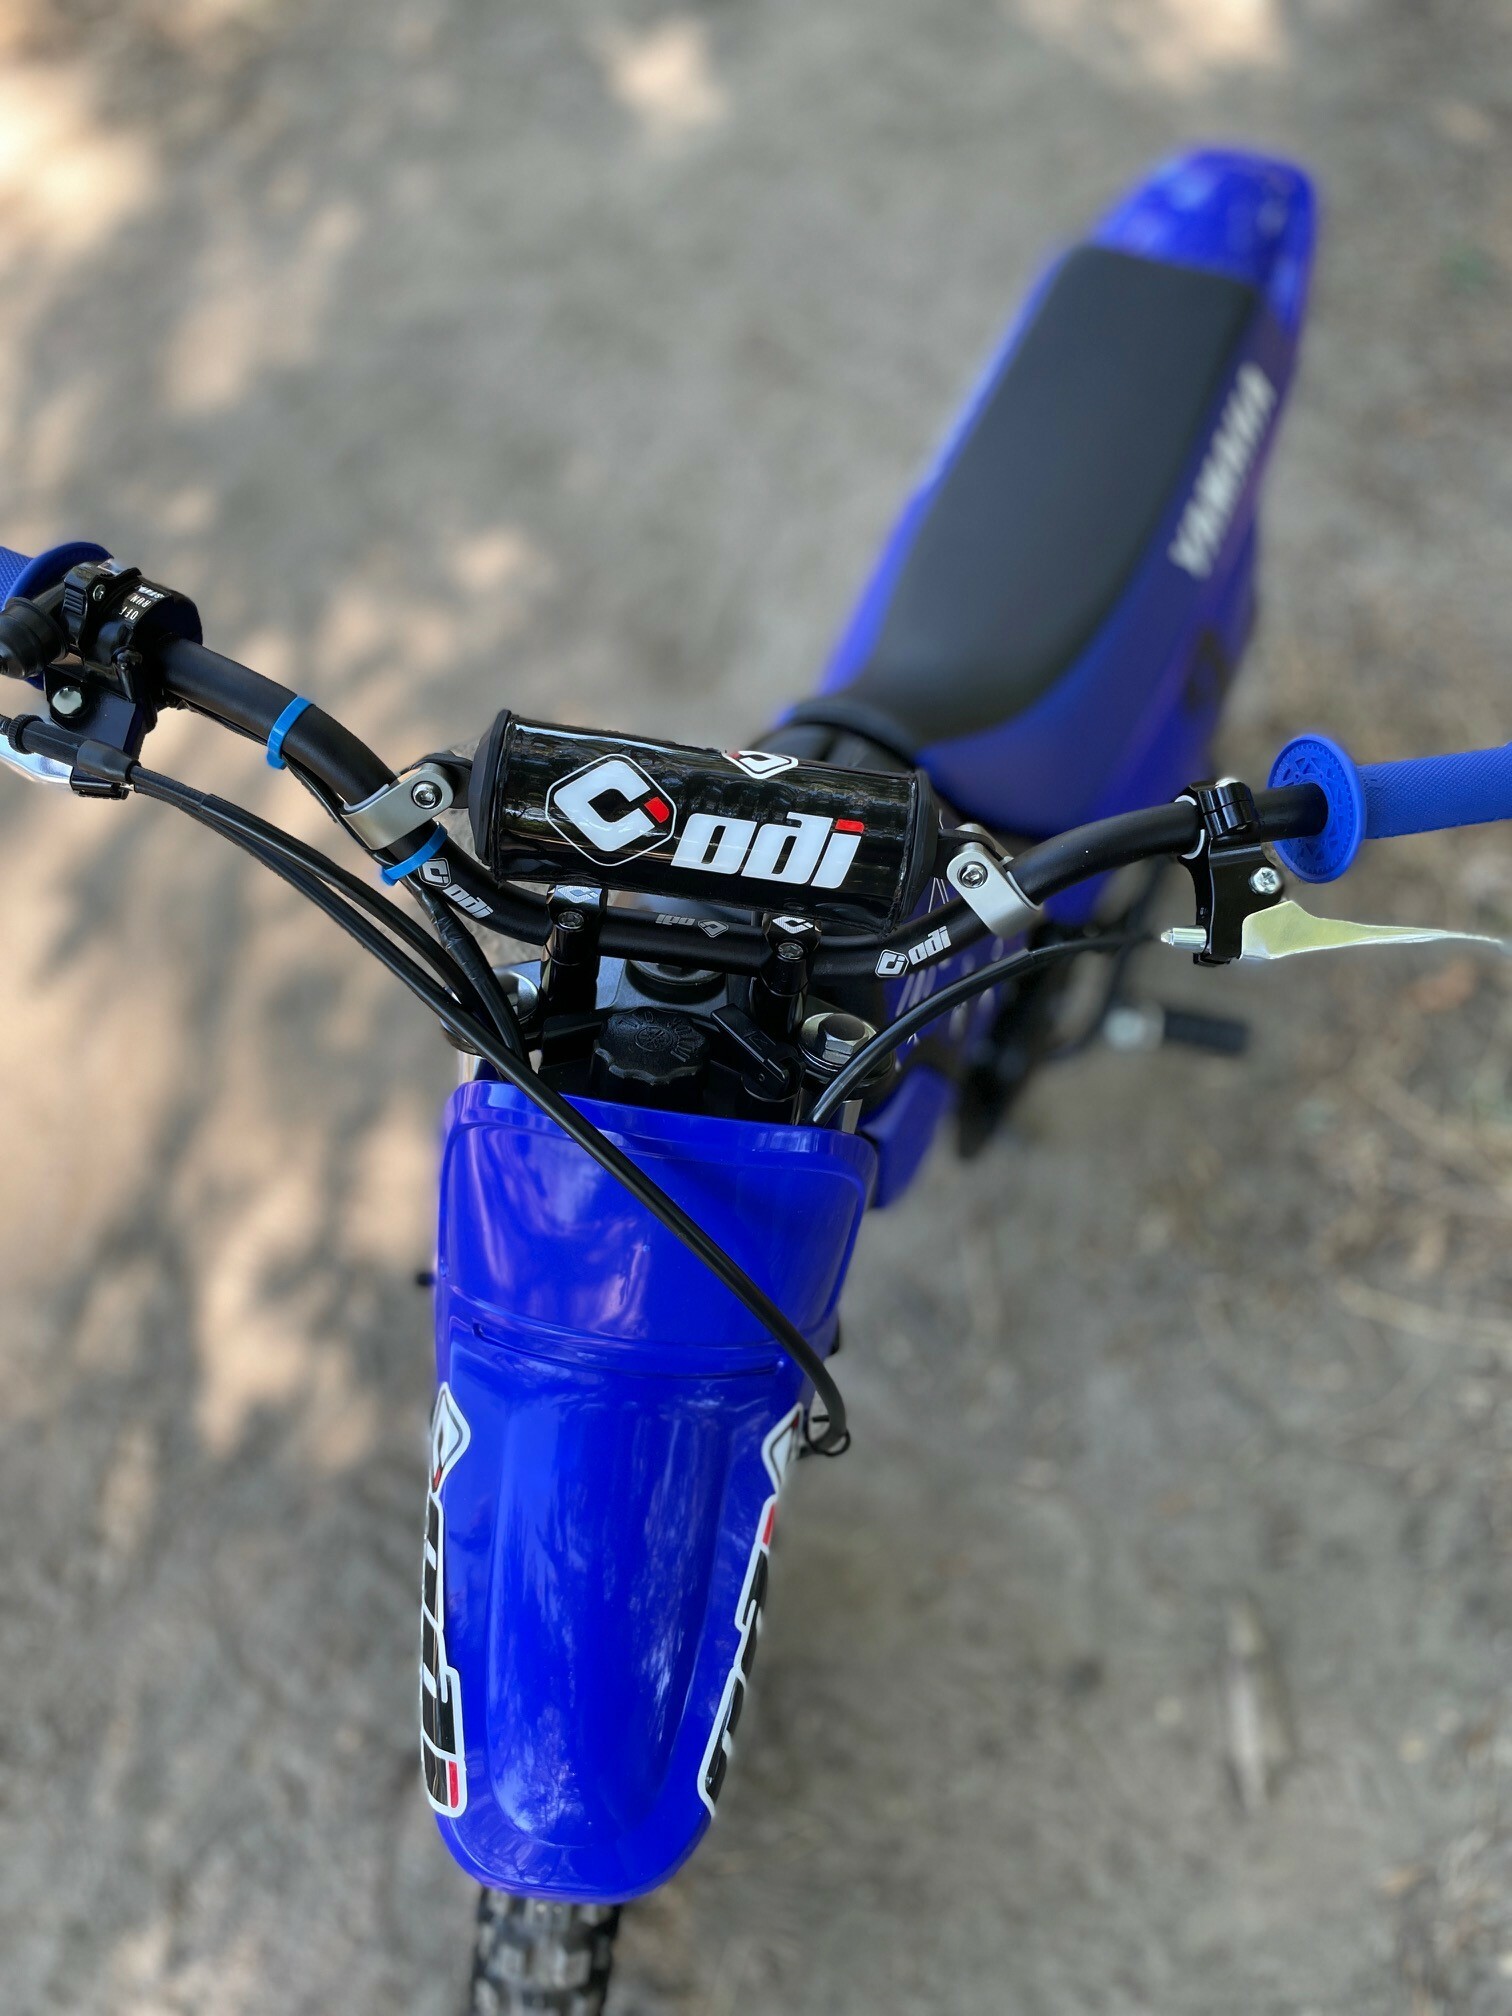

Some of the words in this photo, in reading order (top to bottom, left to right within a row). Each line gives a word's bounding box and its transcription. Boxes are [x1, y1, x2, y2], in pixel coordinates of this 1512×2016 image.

[119, 606, 139, 620] OFF
[130, 594, 151, 608] RUN
[671, 811, 865, 889] odi
[443, 884, 494, 919] odi
[908, 926, 952, 965] odi
